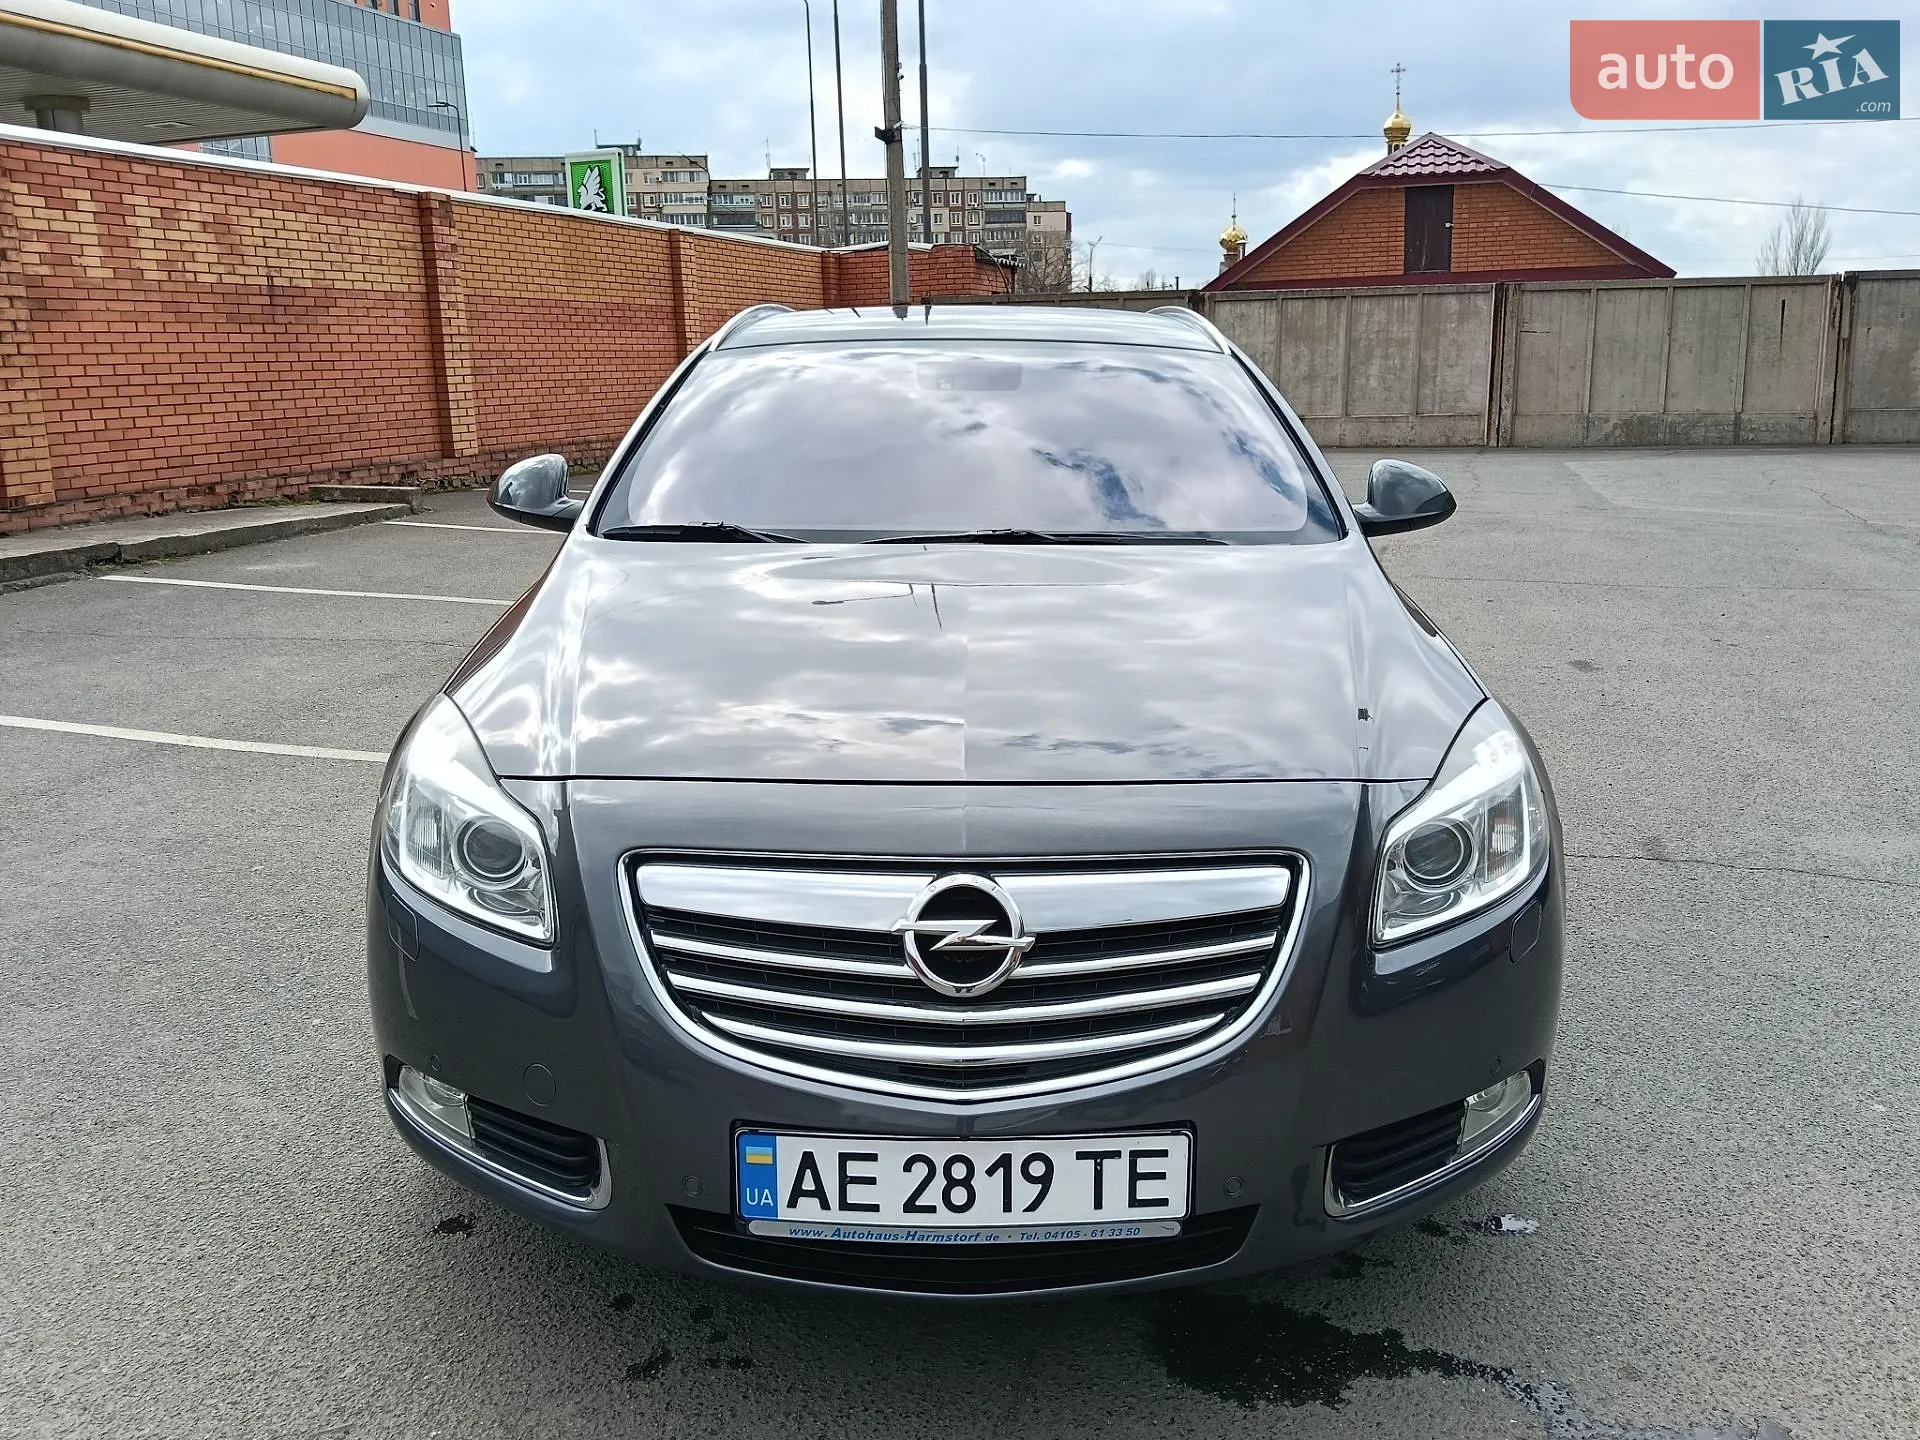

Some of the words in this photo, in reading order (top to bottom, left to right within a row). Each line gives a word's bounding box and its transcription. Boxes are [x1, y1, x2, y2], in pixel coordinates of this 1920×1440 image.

[786, 1150, 881, 1212] AE
[902, 1152, 1055, 1214] 2819
[1075, 1148, 1170, 1211] TE
[745, 1187, 774, 1208] UA
[1019, 1231, 1039, 1241] Tel.
